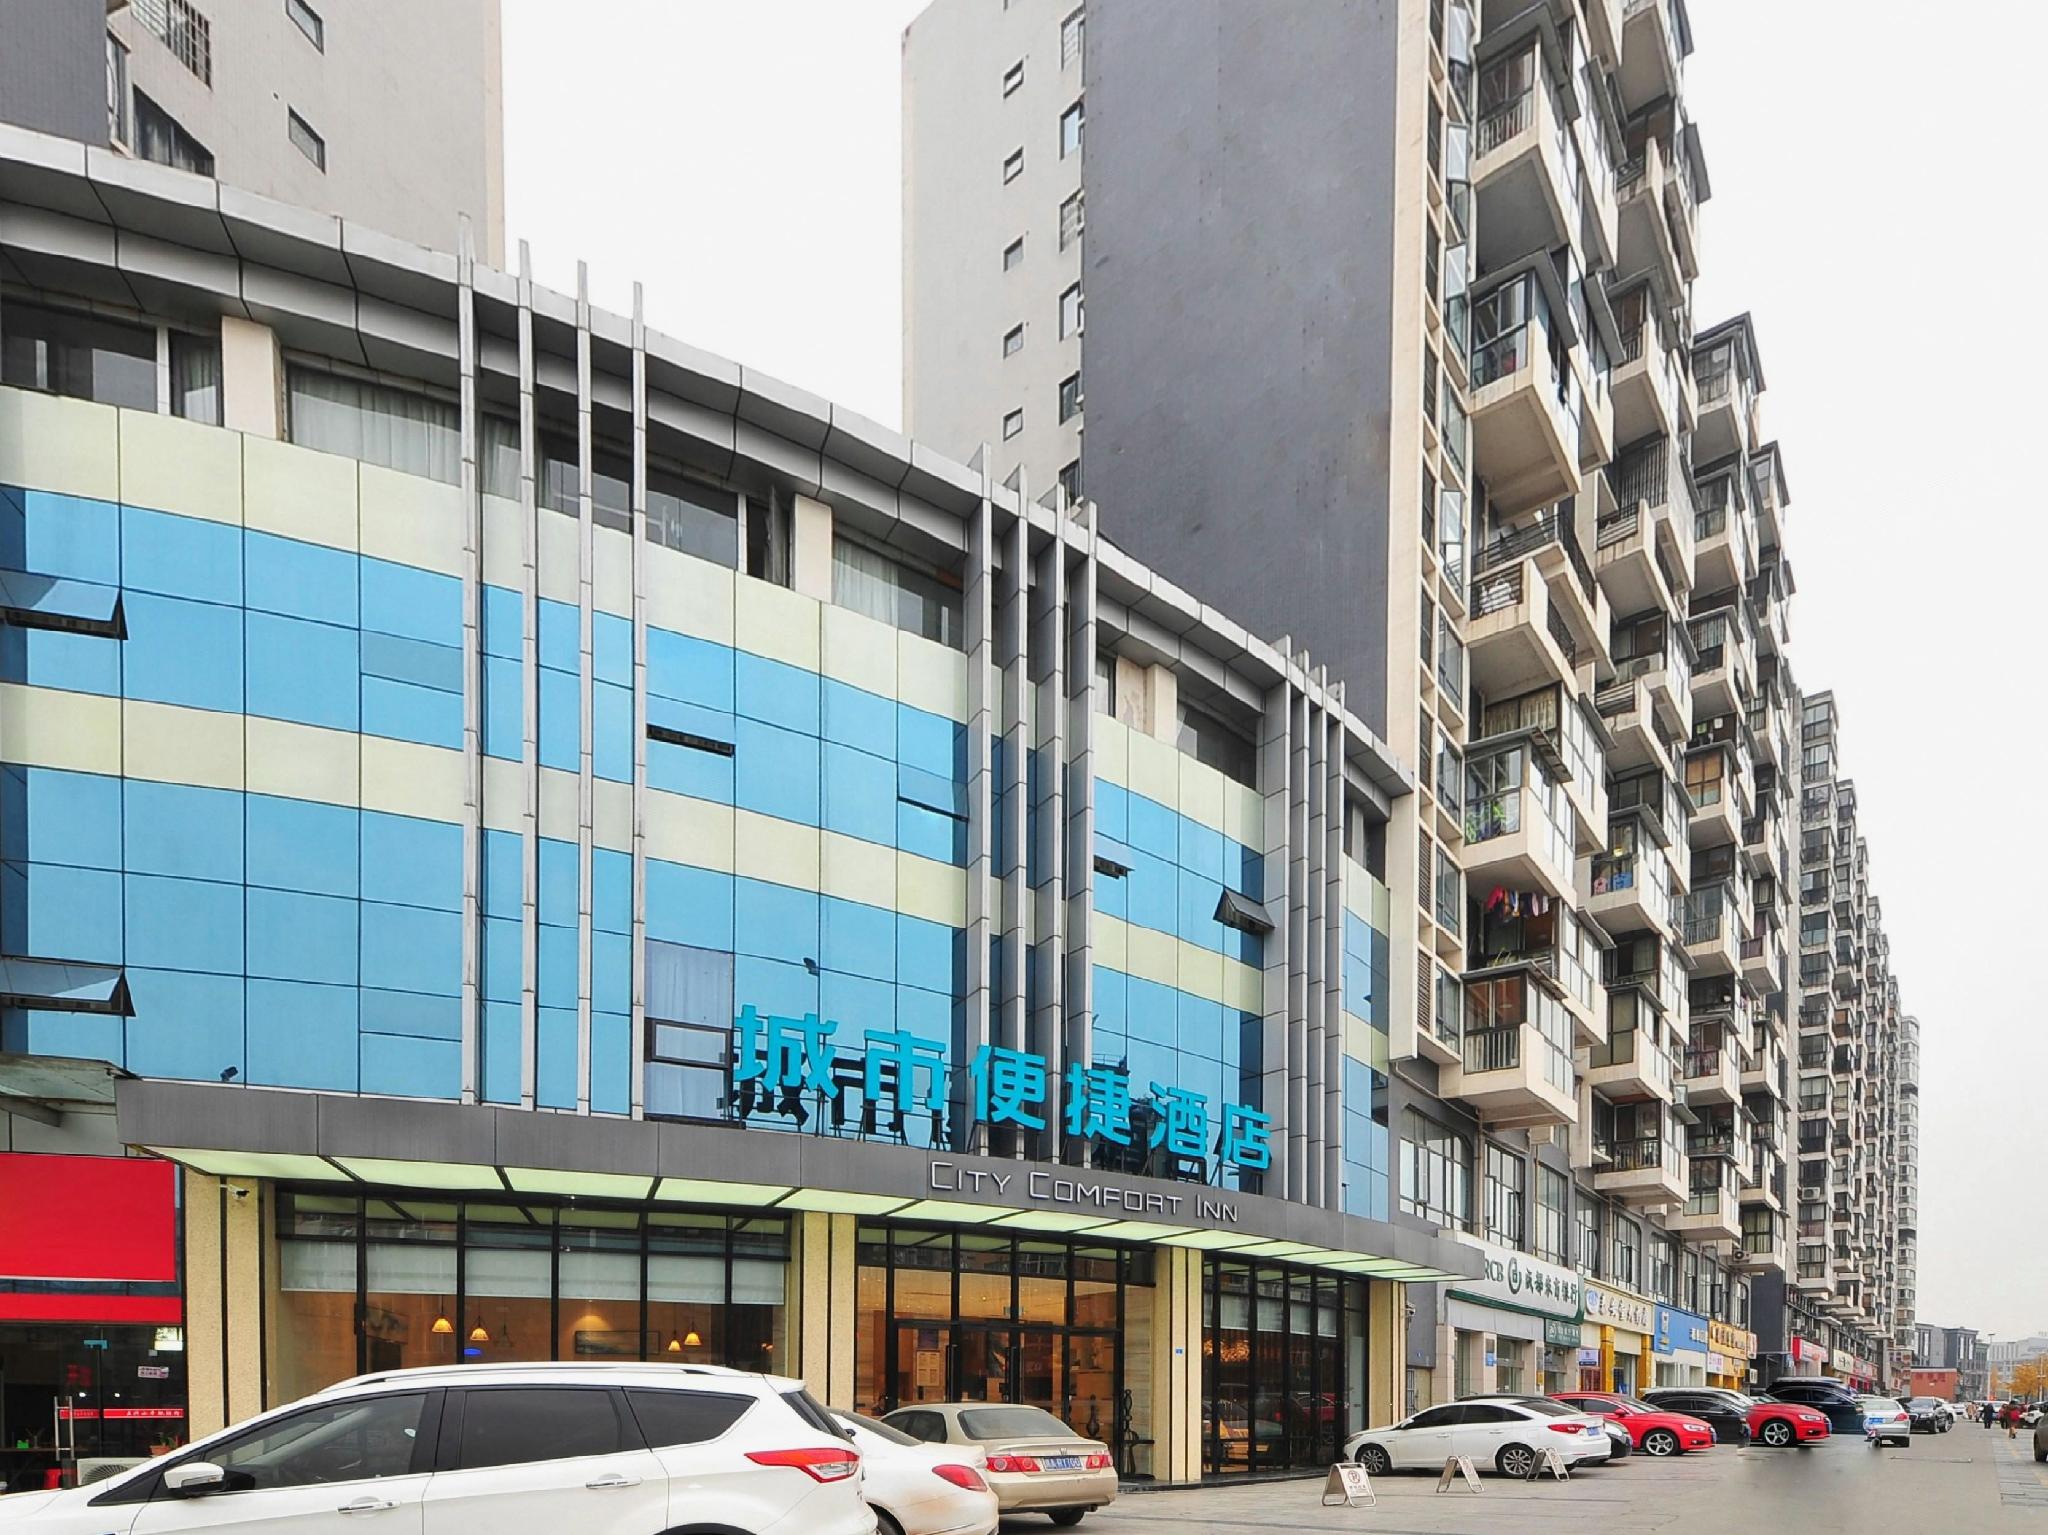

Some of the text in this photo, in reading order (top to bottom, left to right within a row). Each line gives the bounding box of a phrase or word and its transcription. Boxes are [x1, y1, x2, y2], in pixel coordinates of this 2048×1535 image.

[733, 1004, 1273, 1170] 城市便捷酒店
[930, 1161, 1239, 1223] CITY COMFORT INN
